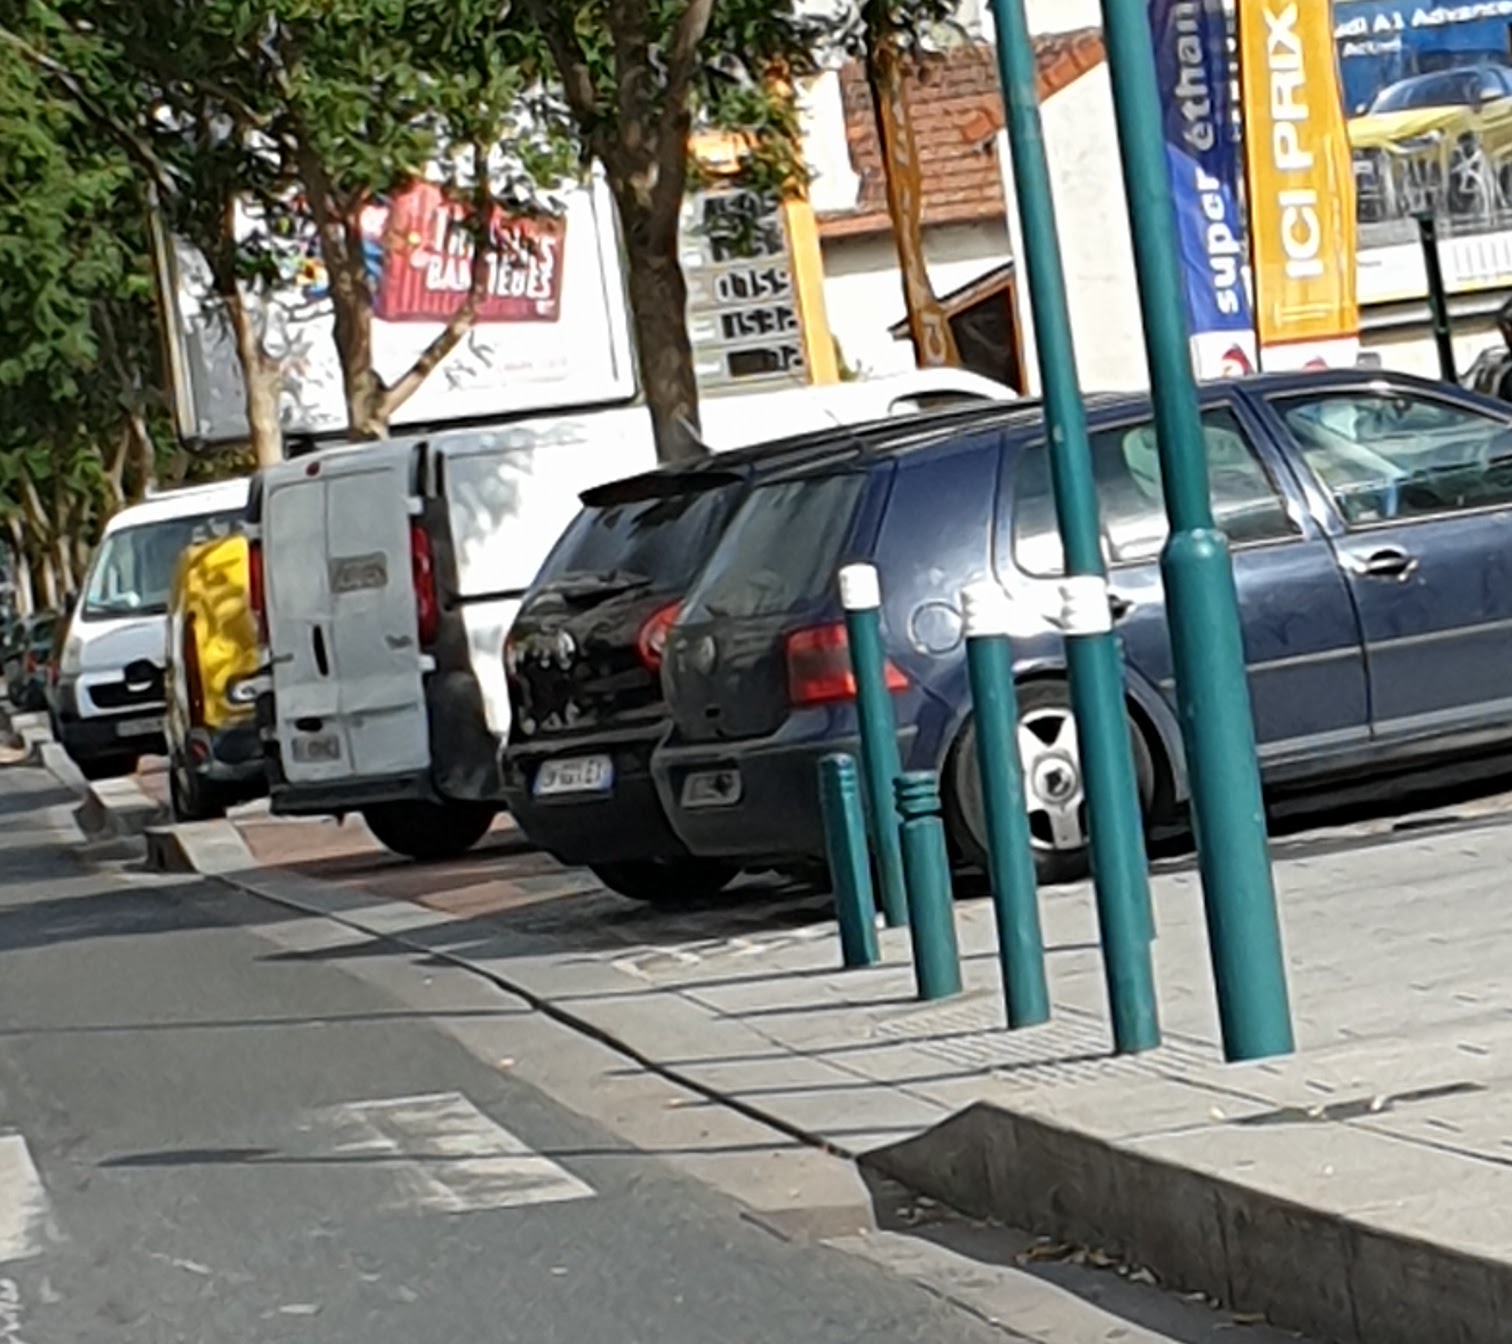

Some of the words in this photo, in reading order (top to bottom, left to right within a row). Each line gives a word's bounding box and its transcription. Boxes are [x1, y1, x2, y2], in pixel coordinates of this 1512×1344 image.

[1262, 2, 1314, 172] PRIX
[1196, 165, 1240, 316] super
[1279, 187, 1325, 280] ICI
